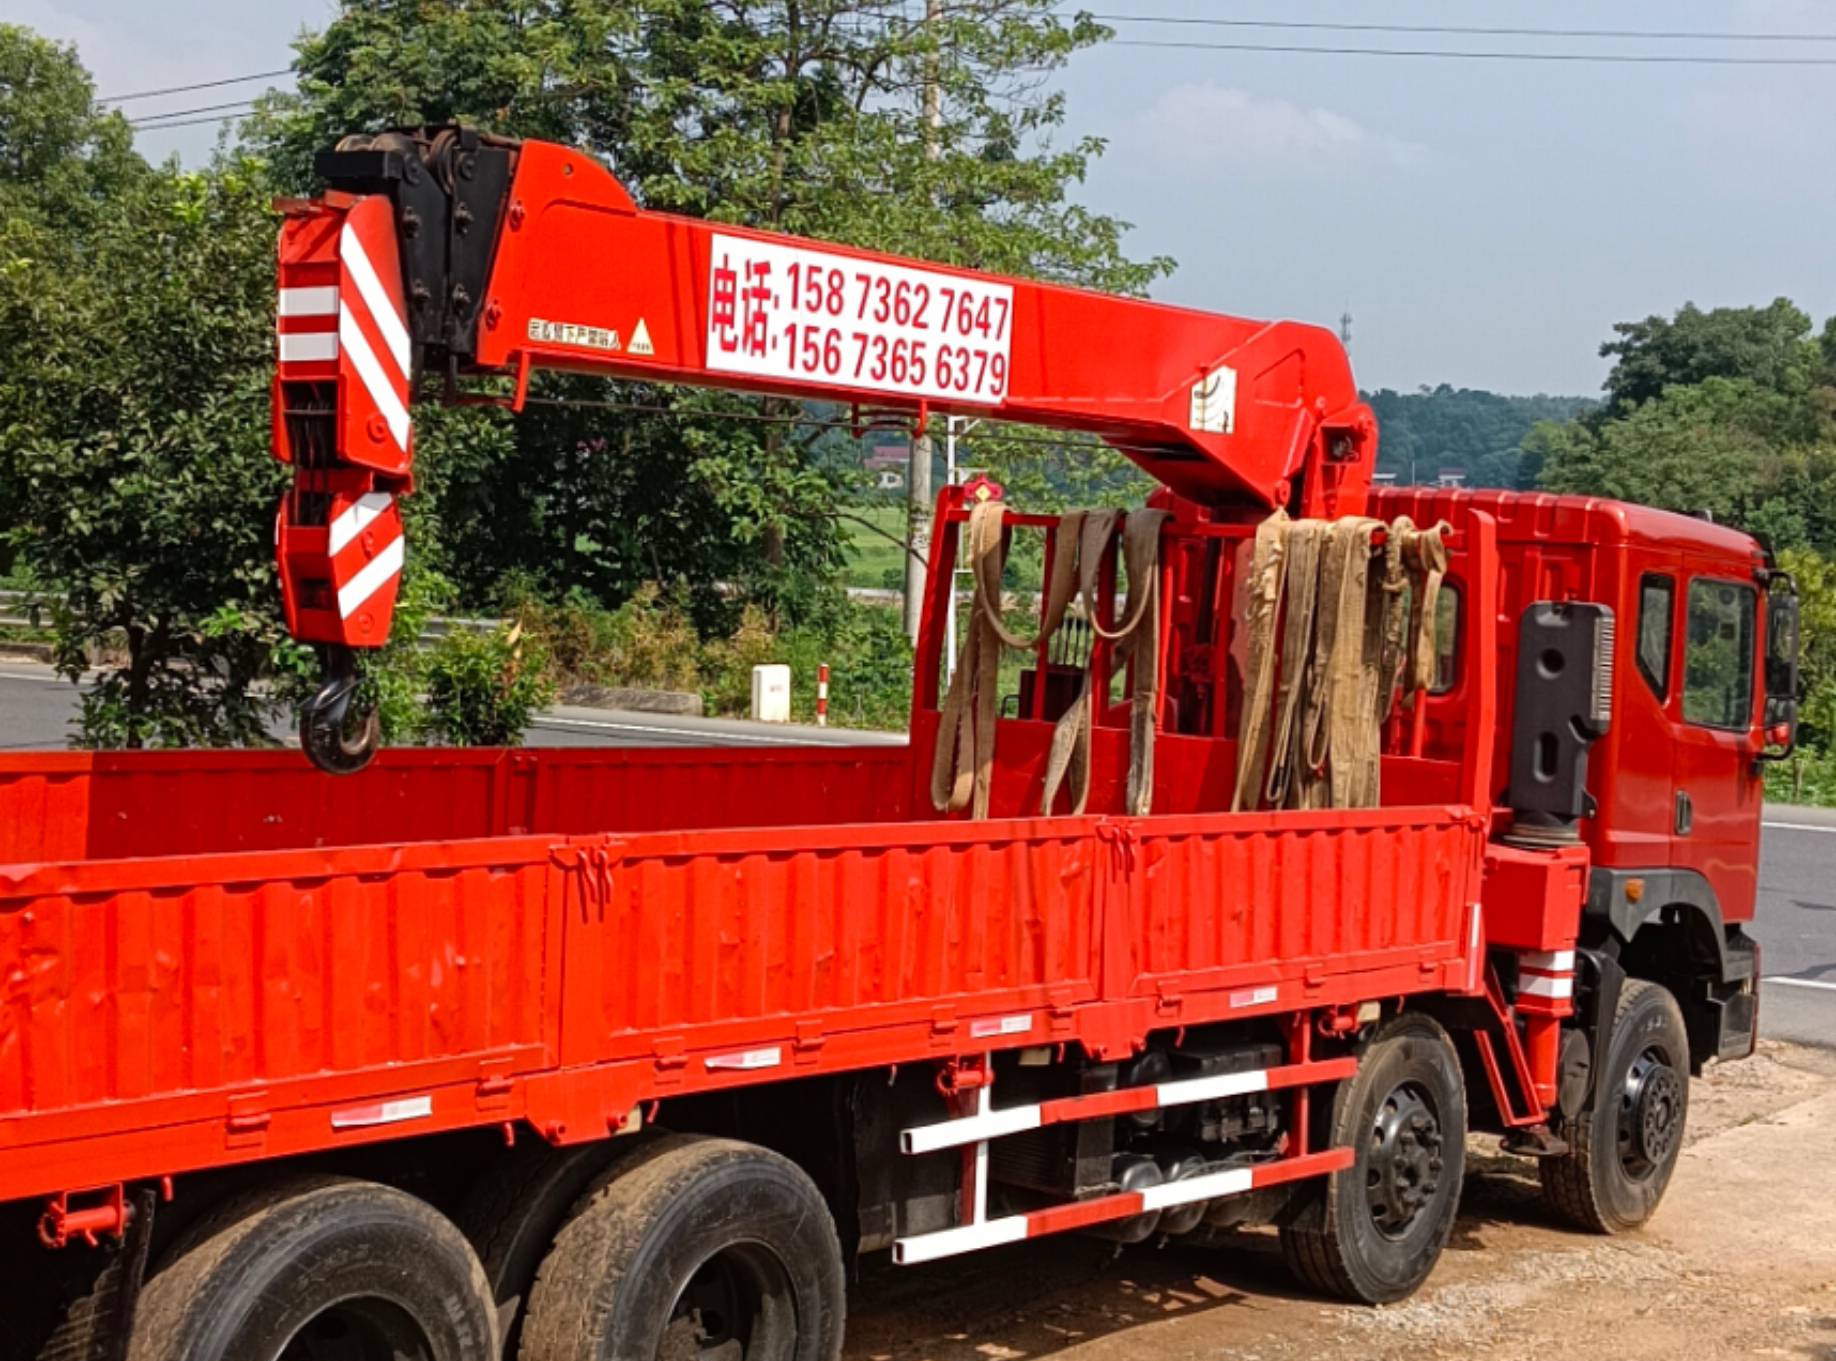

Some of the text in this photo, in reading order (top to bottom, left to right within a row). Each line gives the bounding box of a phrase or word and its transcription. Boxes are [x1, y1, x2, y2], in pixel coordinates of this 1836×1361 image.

[787, 261, 1009, 341] 158 7362 7647
[784, 322, 1006, 396] 156 7365 6379
